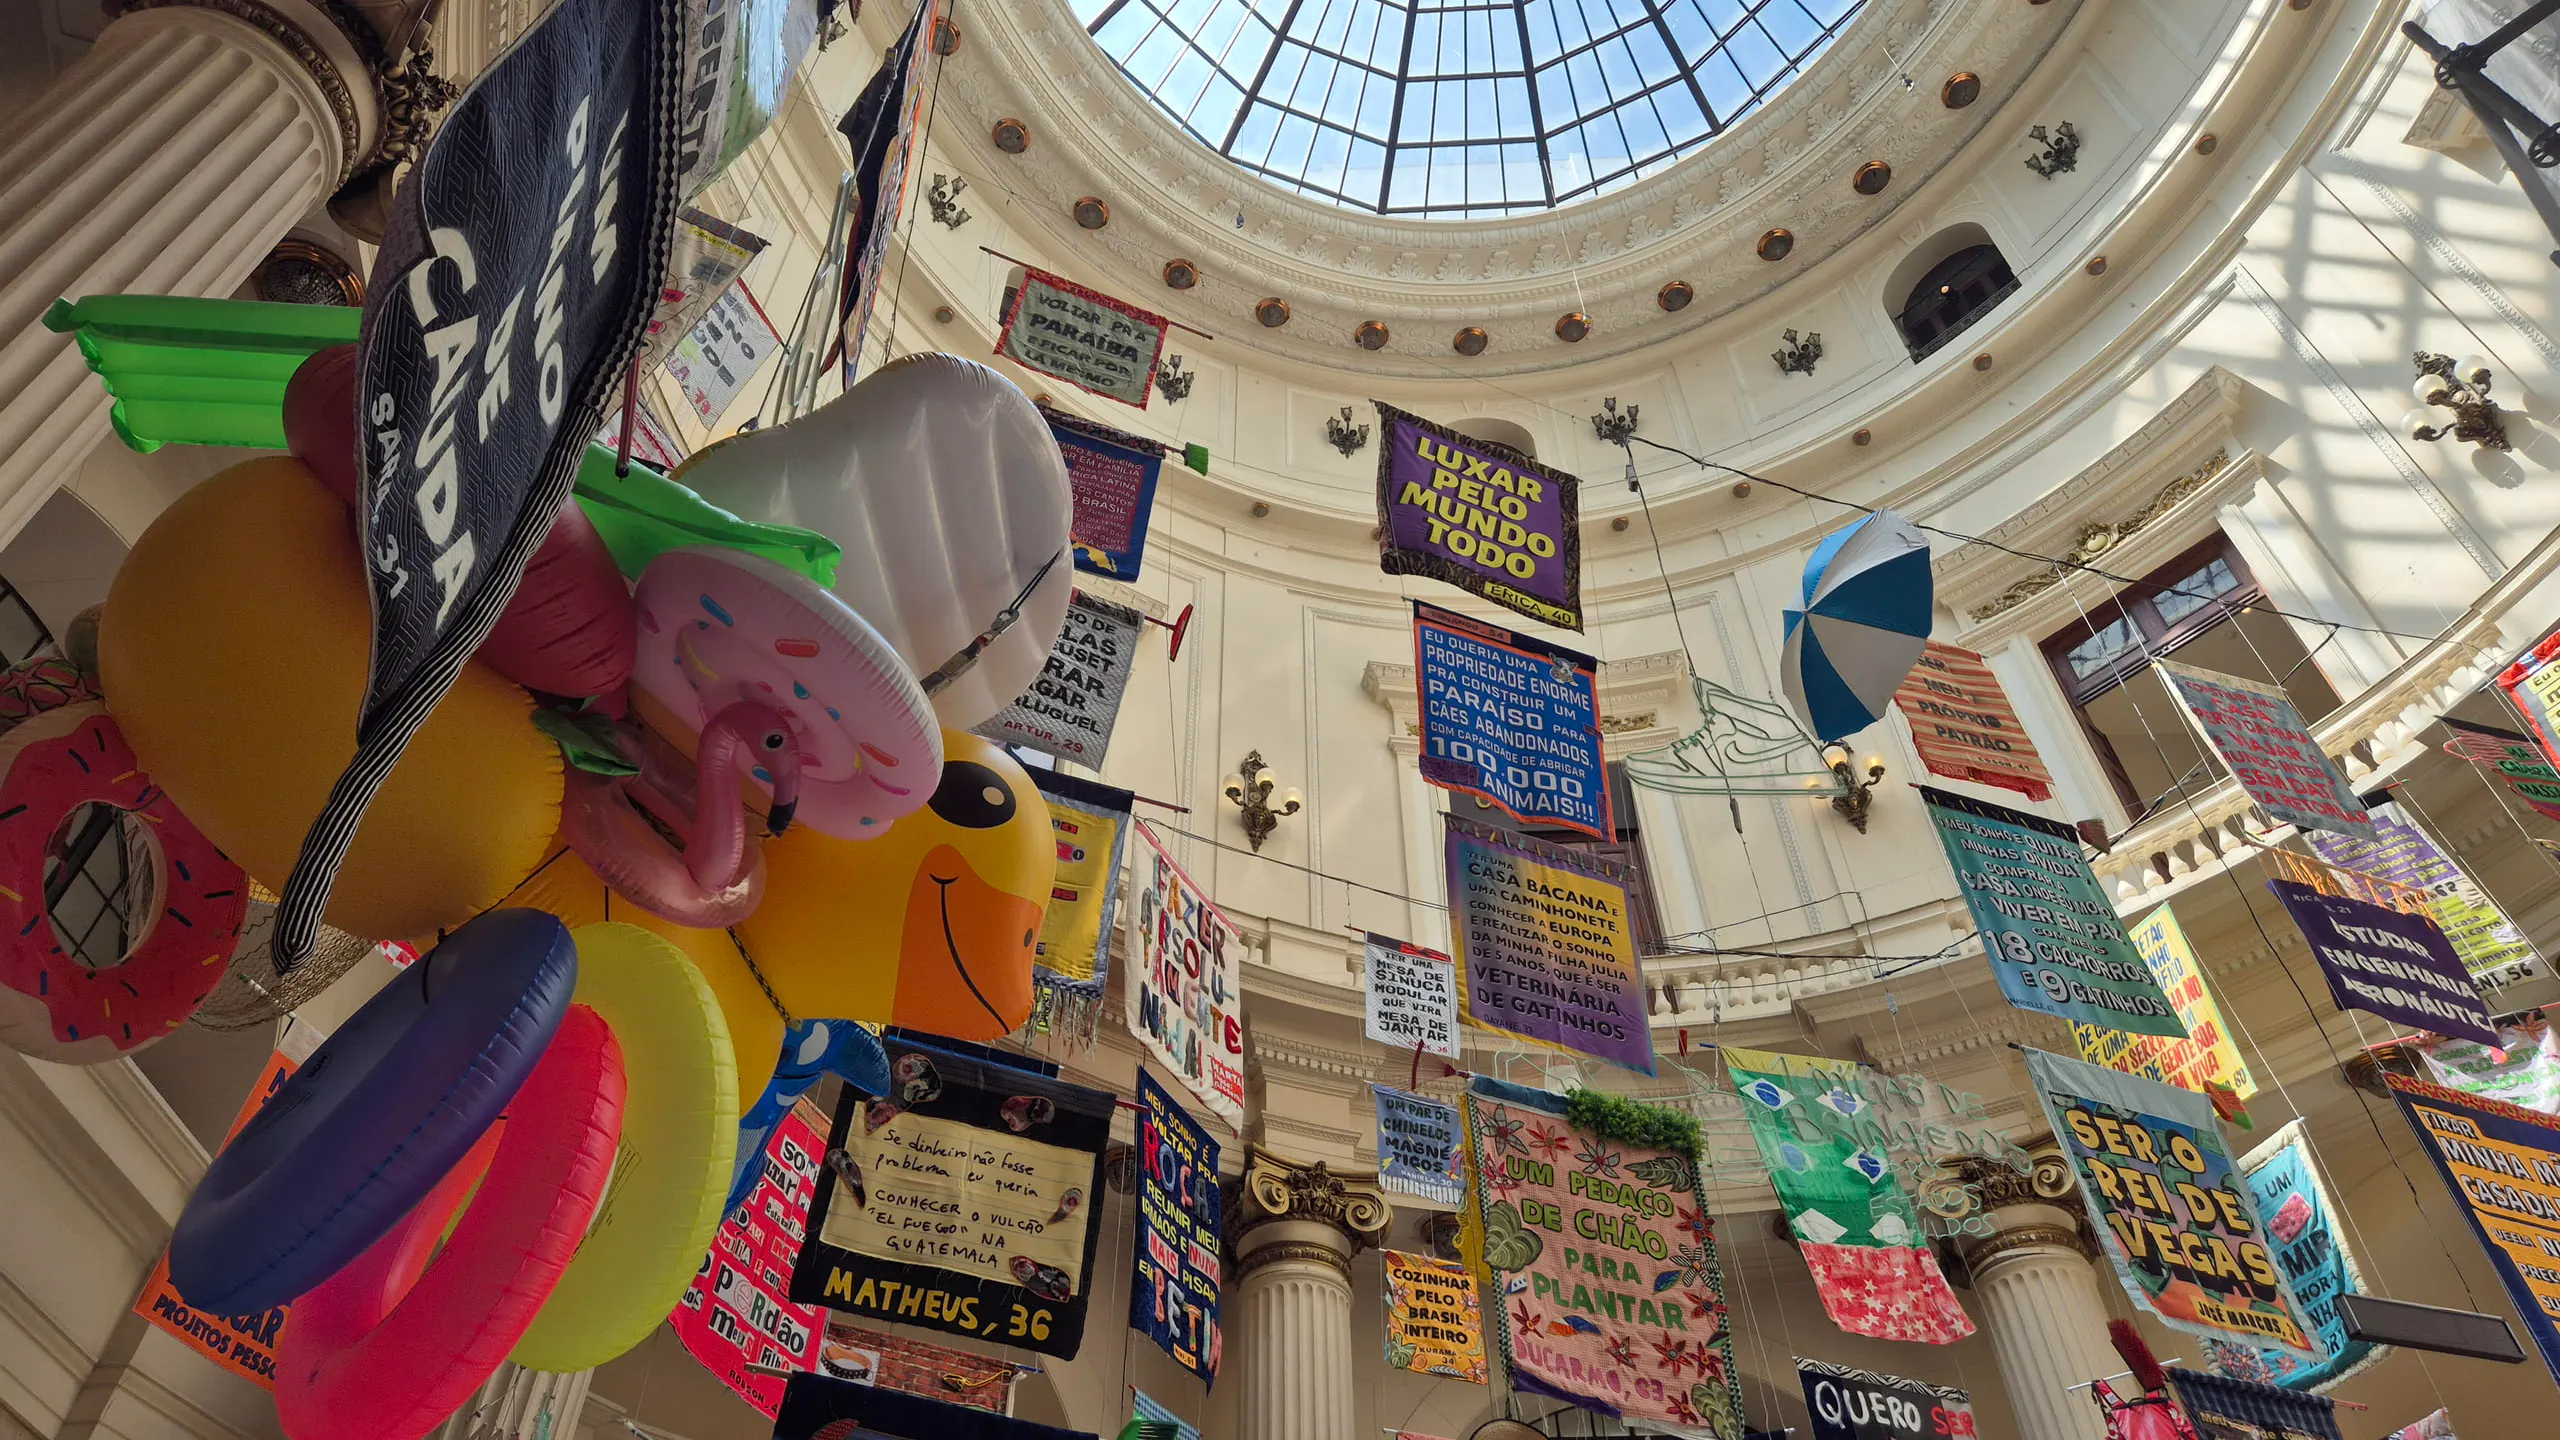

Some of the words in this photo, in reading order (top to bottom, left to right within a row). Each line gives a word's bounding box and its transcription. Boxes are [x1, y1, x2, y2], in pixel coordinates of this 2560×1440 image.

[593, 108, 629, 285] UM
[533, 94, 590, 428] PIANO
[1028, 313, 1139, 363] PARAÍBA
[1038, 293, 1101, 326] VOLTAR
[1111, 320, 1147, 342] PRA
[478, 286, 526, 444] DE
[1039, 337, 1091, 363] FICAR
[1095, 358, 1131, 375] POR
[1050, 359, 1115, 387] MESMO
[408, 226, 477, 634] CAUDA
[1080, 455, 1095, 467] EM
[1096, 453, 1142, 470] DINHEIRO
[1417, 436, 1543, 503] LUXAR
[1079, 486, 1092, 494] OS
[1095, 491, 1133, 507] CANTOS
[1101, 476, 1136, 491] LATINA
[1432, 468, 1528, 521] PELO
[1400, 481, 1556, 558] MUNDO
[1427, 516, 1536, 579] TODO
[1091, 618, 1116, 635] DE
[1552, 609, 1572, 624] 40
[1425, 630, 1444, 644] EU
[1448, 637, 1501, 663] QUERIA
[1506, 654, 1539, 673] UMA
[1427, 644, 1526, 691] PROPRIEDADE
[1531, 678, 1591, 711] ENORME
[1428, 664, 1457, 682] PRA
[1462, 675, 1545, 710] CONSTRUIR
[1554, 704, 1576, 720] UM
[1923, 678, 1963, 698] MEU
[1429, 679, 1544, 730] PARAÍSO
[1552, 724, 1587, 744] PARA
[1917, 700, 2002, 729] PRÓPRIO
[1062, 739, 1085, 754] 29
[1429, 699, 1469, 726] CÃES
[1475, 716, 1594, 769] ABANDONADOS,
[1431, 721, 1454, 737] COM
[1458, 730, 1518, 763] CAPACIDADE
[1521, 756, 1536, 766] DE
[1539, 759, 1586, 779] ABRIGAR
[1935, 724, 2011, 753] PATRÃO
[1431, 737, 1584, 799] 100.000
[1483, 772, 1595, 823] ANIMAIS!!!
[1490, 858, 1514, 871] UMA
[1960, 839, 2020, 860] MINHAS
[2024, 835, 2083, 864] QUITAR
[1468, 863, 1521, 888] CASA
[1527, 880, 1609, 914] BACANA
[1960, 869, 2023, 898] CASA
[1984, 861, 2052, 888] COMPRAR
[1468, 883, 1497, 897] UMA
[1500, 891, 1620, 934] CAMINHONETE,
[1469, 900, 1535, 925] CONHECER
[1549, 921, 1613, 948] EUROPA
[1989, 896, 2055, 924] VIVER
[2056, 910, 2084, 935] EM
[1471, 931, 1491, 944] DA
[1496, 935, 1545, 957] MINHA
[1548, 950, 1588, 970] FILHA
[1483, 918, 1549, 944] REALIZAR
[1566, 942, 1616, 964] SONHO
[1984, 928, 2037, 966] 18
[2036, 941, 2156, 987] CACHORROS
[1375, 970, 1445, 994] SINUCA
[1376, 959, 1415, 978] MESA
[1424, 971, 1445, 982] DE
[1412, 959, 1433, 970] UMA
[1472, 946, 1492, 959] DE
[1506, 954, 1550, 976] ANOS,
[1553, 969, 1581, 985] QUE
[1597, 979, 1622, 995] SER
[2319, 945, 2481, 1000] ENGENHARIA
[1374, 983, 1448, 1006] MODULAR
[1382, 998, 1407, 1009] QUE
[1412, 1003, 1442, 1017] VIRA
[1474, 964, 1622, 1017] VETERINÁRIA
[2038, 969, 2071, 1004] 9
[2069, 979, 2170, 1018] GATINHOS
[1378, 1010, 1420, 1026] MESA
[1429, 1019, 1448, 1032] DE
[1379, 1020, 1449, 1042] JANTAR
[1477, 987, 1504, 1009] DE
[1510, 996, 1626, 1042] GATINHOS
[2160, 1038, 2197, 1075] GENTE
[2188, 1050, 2220, 1085] VIVA
[1145, 1088, 1164, 1116] MEU
[1168, 1112, 1197, 1151] SONHO
[1383, 1118, 1452, 1144] CHINELOS
[1408, 1104, 1431, 1120] PAR
[1435, 1111, 1450, 1123] DE
[2420, 1111, 2479, 1140] TIRAR
[883, 1128, 902, 1145] Se
[908, 1133, 968, 1159] dinheiro
[974, 1149, 996, 1166] não
[1000, 1153, 1035, 1176] fosse
[1152, 1111, 1193, 1167] VOLTAR
[1198, 1161, 1219, 1189] PRA
[1392, 1150, 1444, 1174] TICOS
[2064, 1107, 2160, 1164] SER
[2166, 1129, 2207, 1175] O
[2438, 1136, 2535, 1182] MINHA
[876, 1154, 950, 1179] problema
[967, 1170, 985, 1184] eu
[995, 1178, 1038, 1199] queria
[1505, 1155, 1555, 1187] UM
[1570, 1171, 1675, 1219] PEDAÇO
[2086, 1157, 2176, 1222] REI
[2176, 1182, 2253, 1238] DE
[2460, 1174, 2523, 1211] CASA
[875, 1189, 962, 1215] CONHECER
[990, 1212, 1045, 1235] VULCÃO
[1147, 1178, 1191, 1233] REUNIR
[886, 1234, 999, 1268] GUATEMALA
[981, 1232, 1006, 1249] NA
[1521, 1199, 1563, 1232] DE
[1574, 1209, 1669, 1261] CHÃO
[1564, 1247, 1642, 1285] PARA
[2105, 1212, 2277, 1297] VEGAS
[1183, 1269, 1216, 1307] PISAR
[1393, 1268, 1470, 1291] COZINHAR
[1415, 1289, 1455, 1306] PELO
[1532, 1271, 1689, 1332] PLANTAR
[152, 1293, 231, 1355] PROJETOS
[823, 1266, 999, 1336] MATHEUS,
[1008, 1303, 1054, 1341] 36
[1409, 1307, 1464, 1326] BRASIL
[2198, 1301, 2226, 1322] JOSÉ
[1404, 1323, 1468, 1344] INTEIRO
[1815, 1380, 1921, 1432] QUERO
[1931, 1405, 1978, 1440] SER
